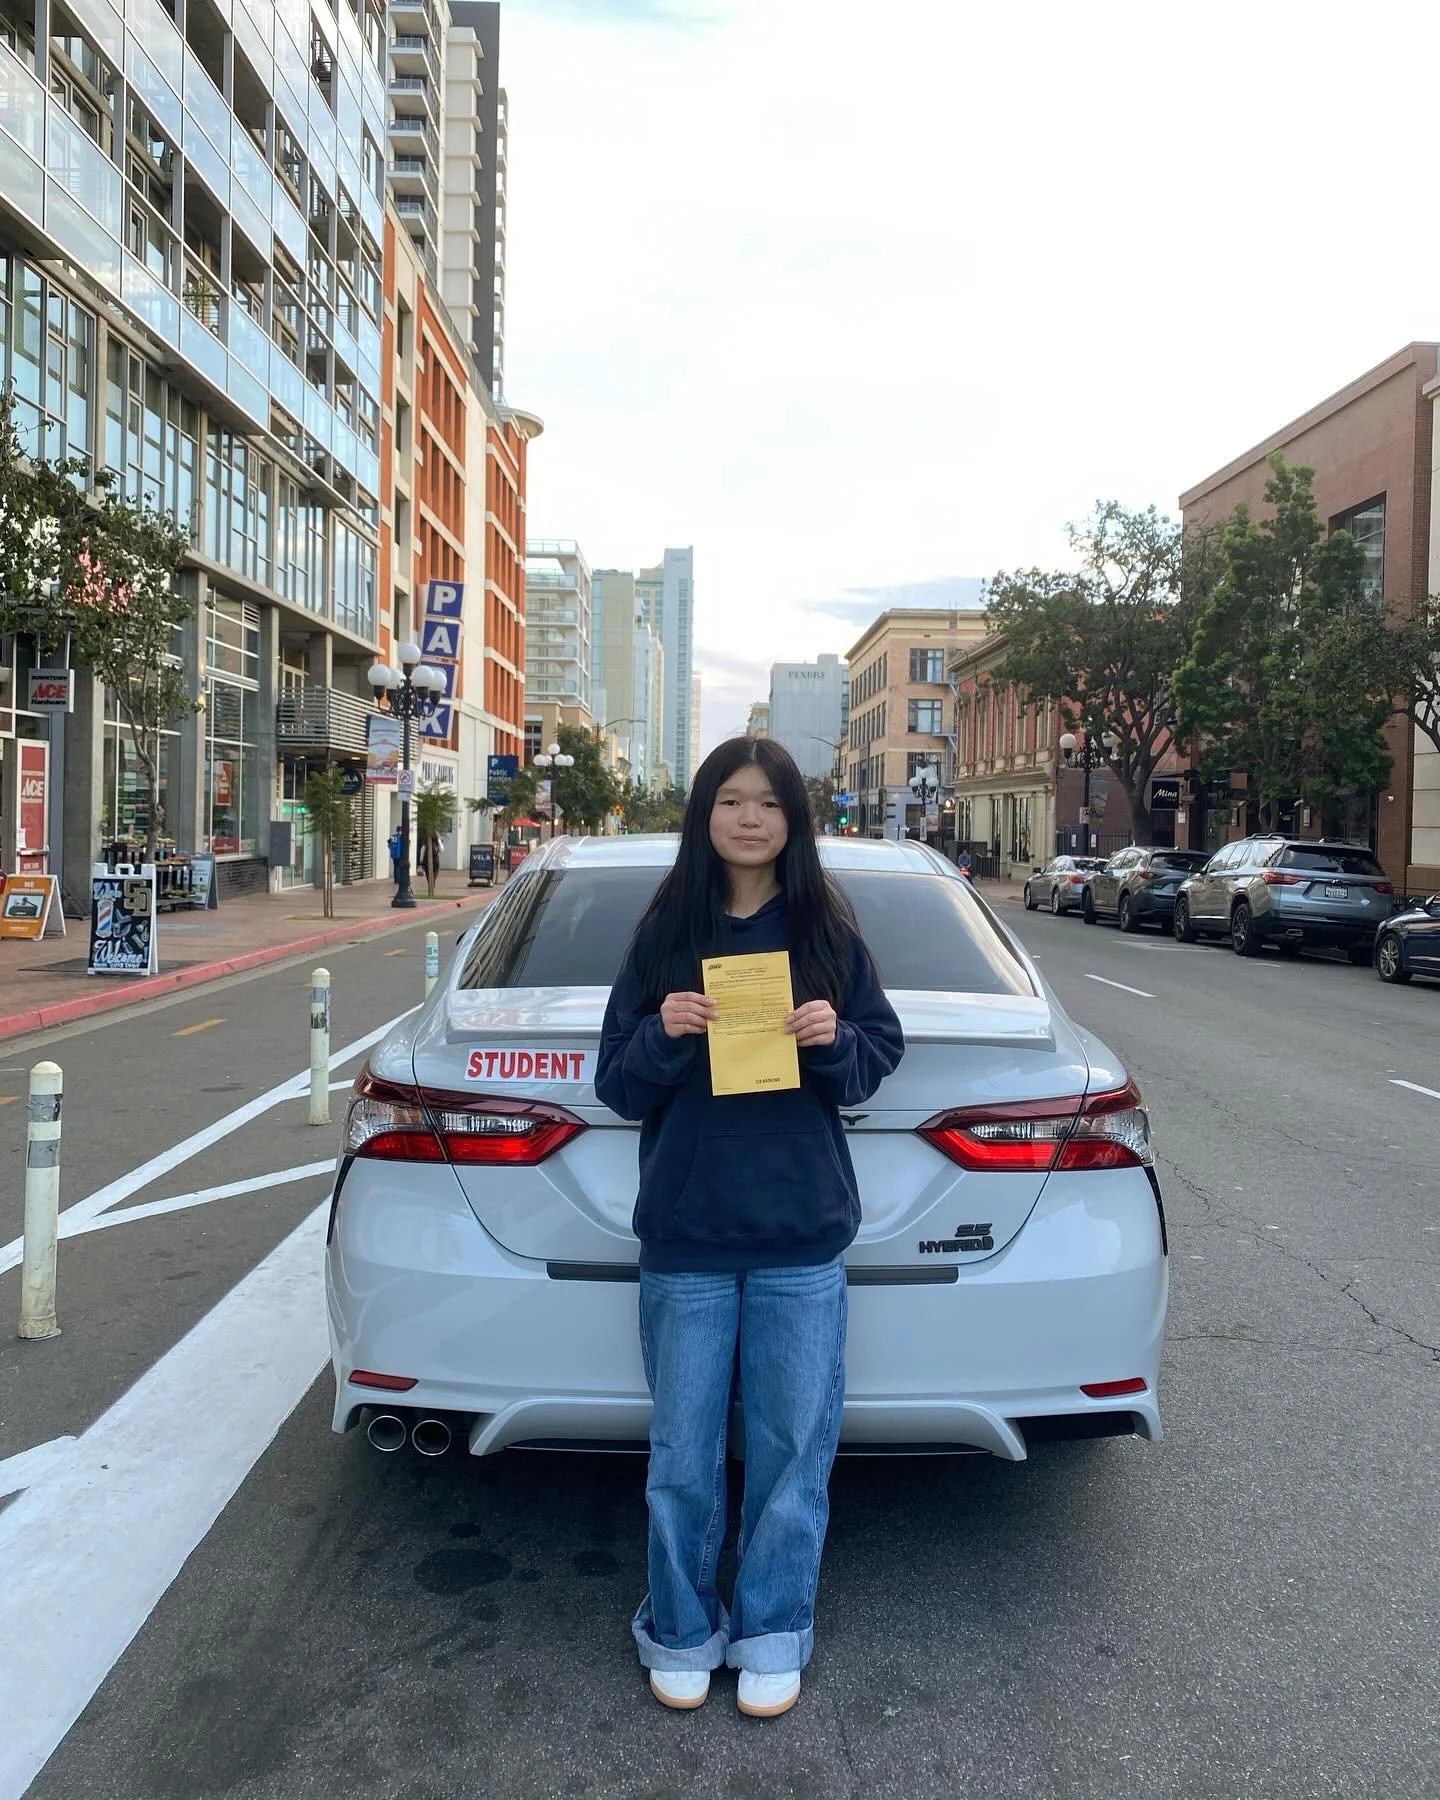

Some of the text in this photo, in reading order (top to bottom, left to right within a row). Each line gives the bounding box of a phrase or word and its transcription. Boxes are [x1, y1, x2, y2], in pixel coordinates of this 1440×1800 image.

[31, 683, 67, 698] ACE
[22, 778, 44, 797] ACE
[1153, 788, 1178, 798] Mina
[467, 1051, 585, 1080] STUDENT
[954, 1223, 993, 1237] SE
[919, 1238, 984, 1254] HYBRID
